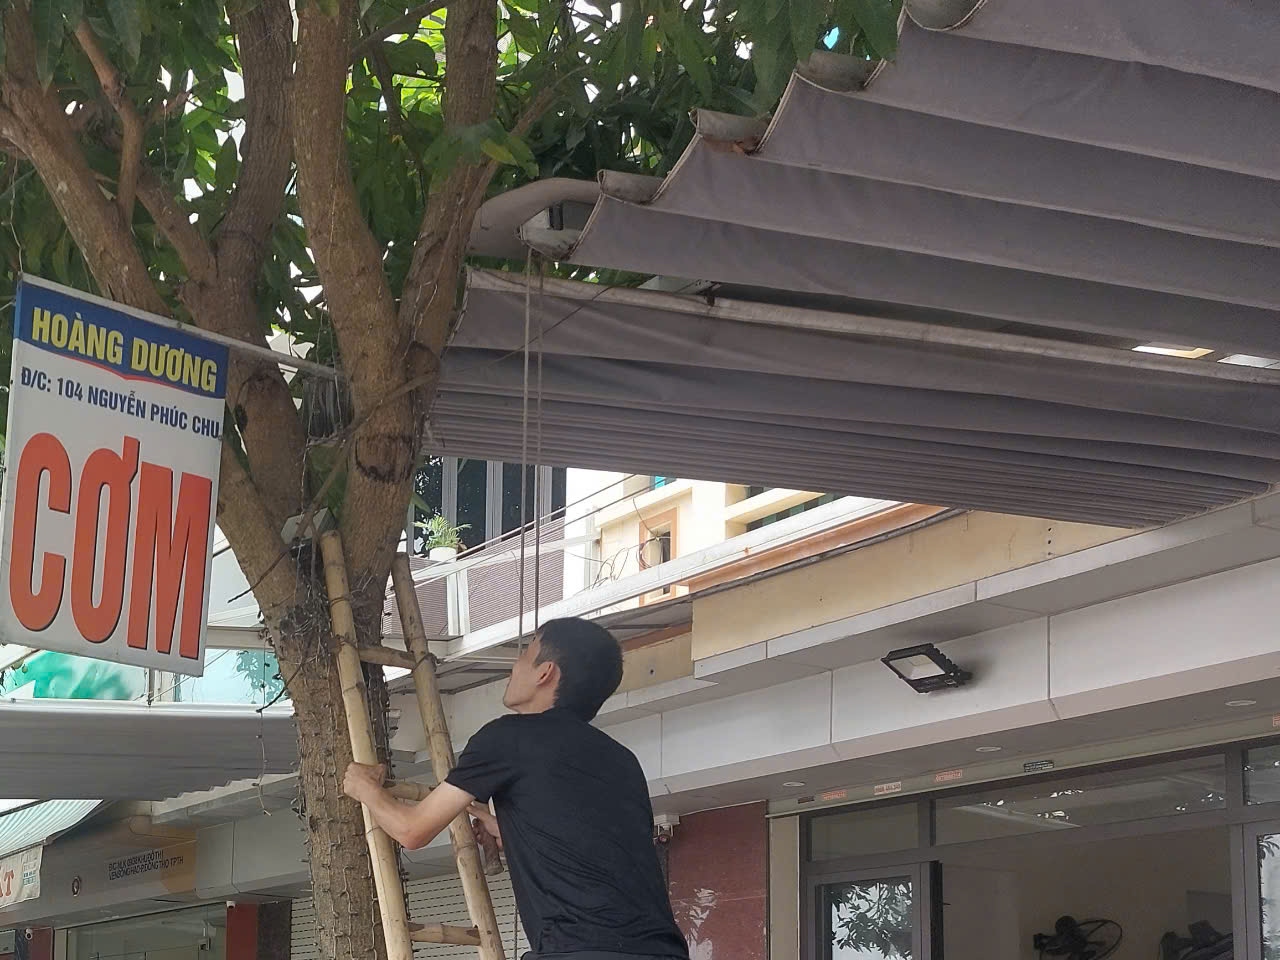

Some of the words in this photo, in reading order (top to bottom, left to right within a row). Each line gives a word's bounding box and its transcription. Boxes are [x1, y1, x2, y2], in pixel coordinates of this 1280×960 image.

[32, 306, 124, 366] HOÀNG
[131, 337, 218, 393] DƯƠNG
[21, 366, 52, 393] Đ/C:
[57, 377, 83, 401] 104
[88, 386, 146, 419] NGUYỄN
[150, 404, 189, 431] PHÚC
[192, 416, 221, 439] CHU
[9, 432, 213, 661] CƠM
